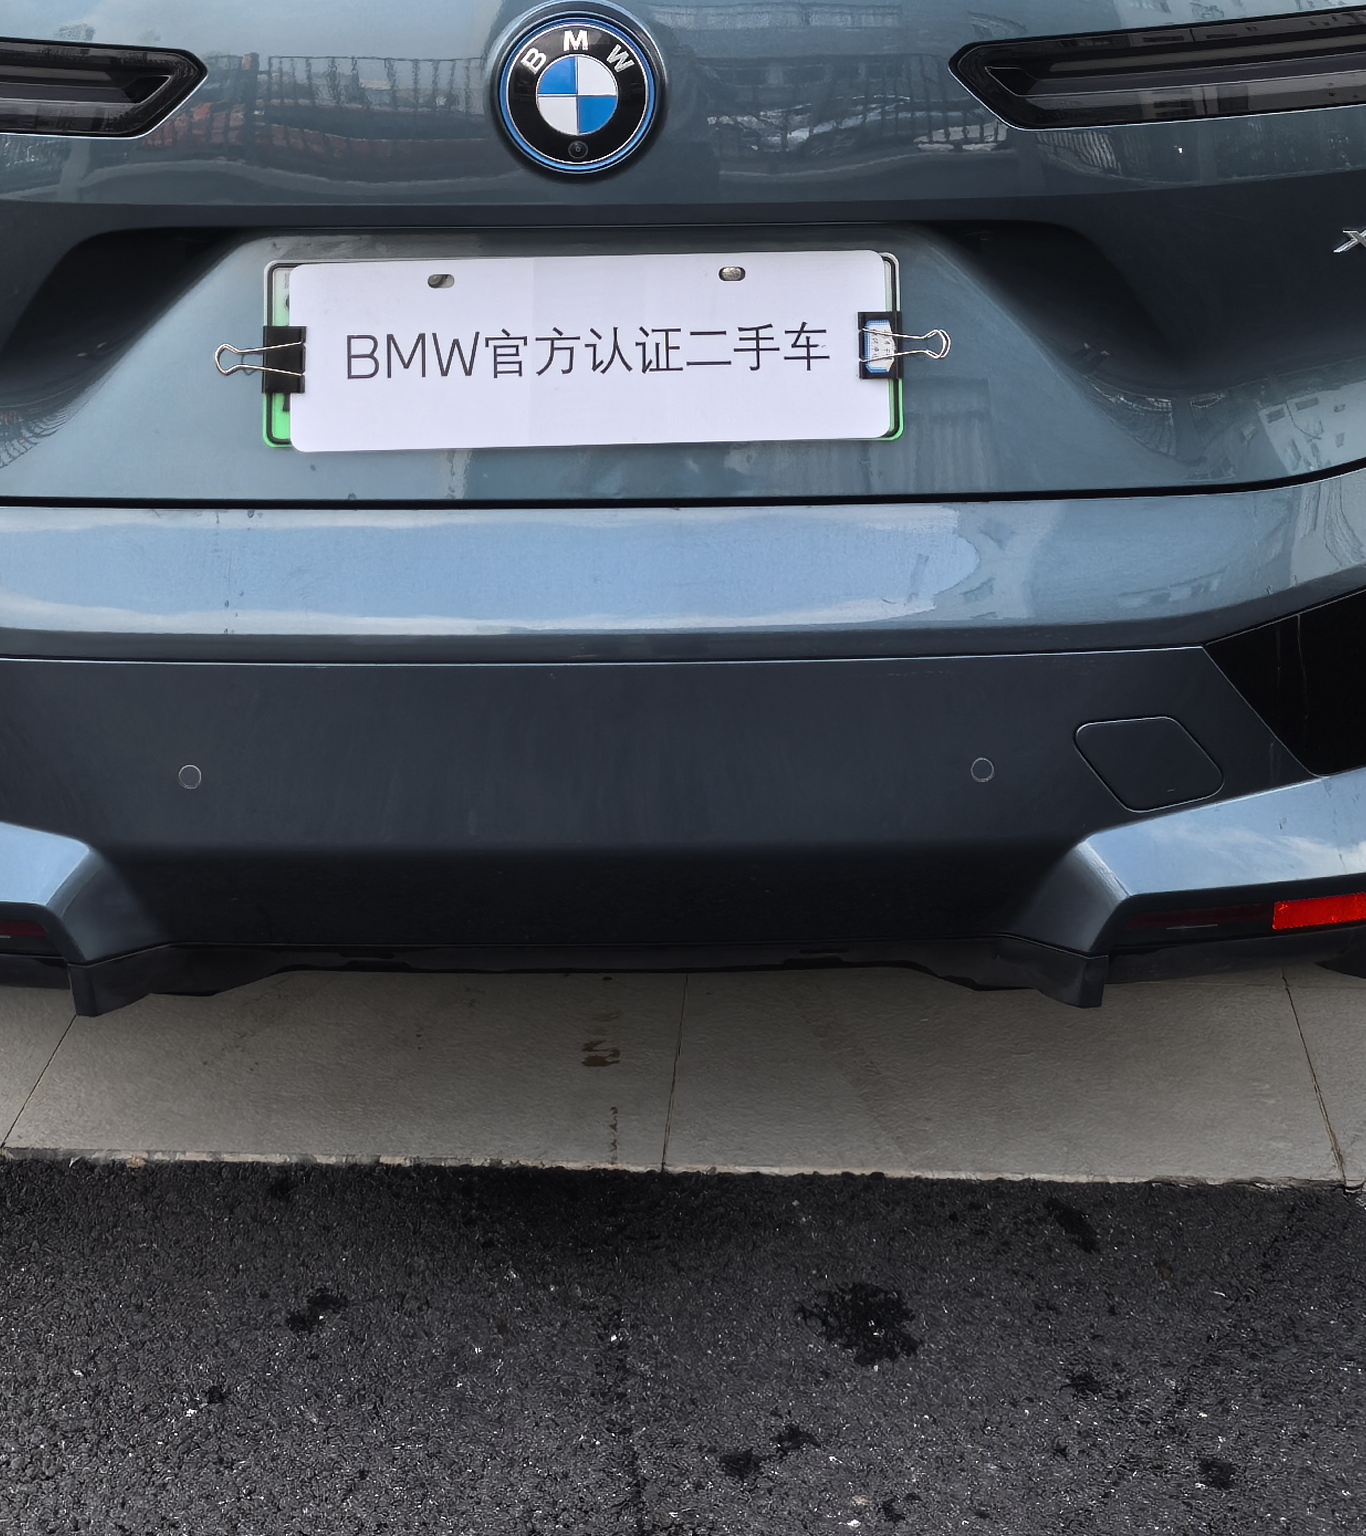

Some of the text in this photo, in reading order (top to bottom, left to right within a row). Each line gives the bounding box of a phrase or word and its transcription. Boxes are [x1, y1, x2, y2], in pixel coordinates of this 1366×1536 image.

[519, 29, 635, 75] BMW
[345, 319, 832, 382] BMW官方认证二手车
